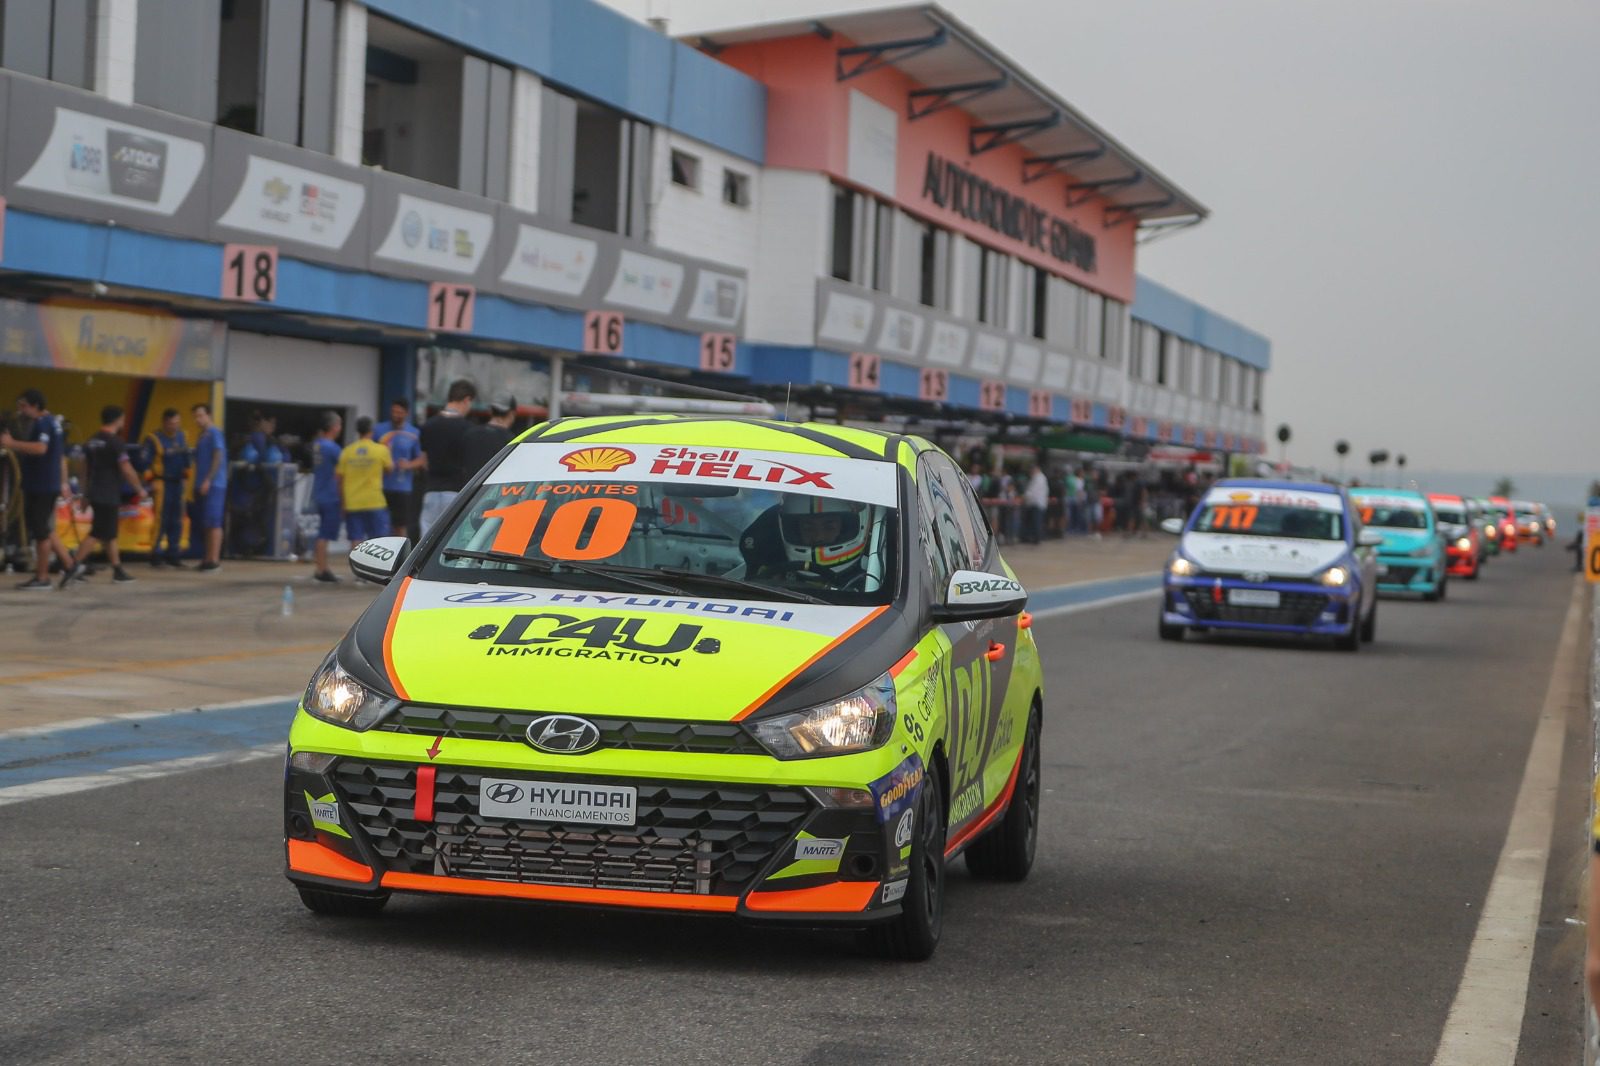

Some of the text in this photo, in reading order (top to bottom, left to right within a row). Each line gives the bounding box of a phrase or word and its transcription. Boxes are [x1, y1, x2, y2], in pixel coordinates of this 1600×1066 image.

[229, 250, 274, 301] 18
[433, 288, 471, 330] 17
[589, 315, 622, 352] 16
[704, 337, 733, 371] 15
[853, 357, 878, 388] 14
[923, 369, 946, 398] 13
[984, 382, 1005, 409] 12
[657, 447, 740, 463] Shell
[649, 458, 835, 490] HELIX
[501, 484, 640, 497] W. PONTES
[482, 497, 639, 562] 10
[1211, 504, 1258, 529] 717
[954, 579, 1021, 596] BRAZZO
[550, 594, 794, 623] HYUNDAI
[493, 613, 704, 655] D4U
[486, 647, 681, 668] IMMIGRATION
[530, 787, 631, 809] HYUNDAI
[313, 807, 335, 819] MARTE
[529, 807, 631, 823] FINANCIAMENTOS
[802, 845, 836, 856] MARTE
